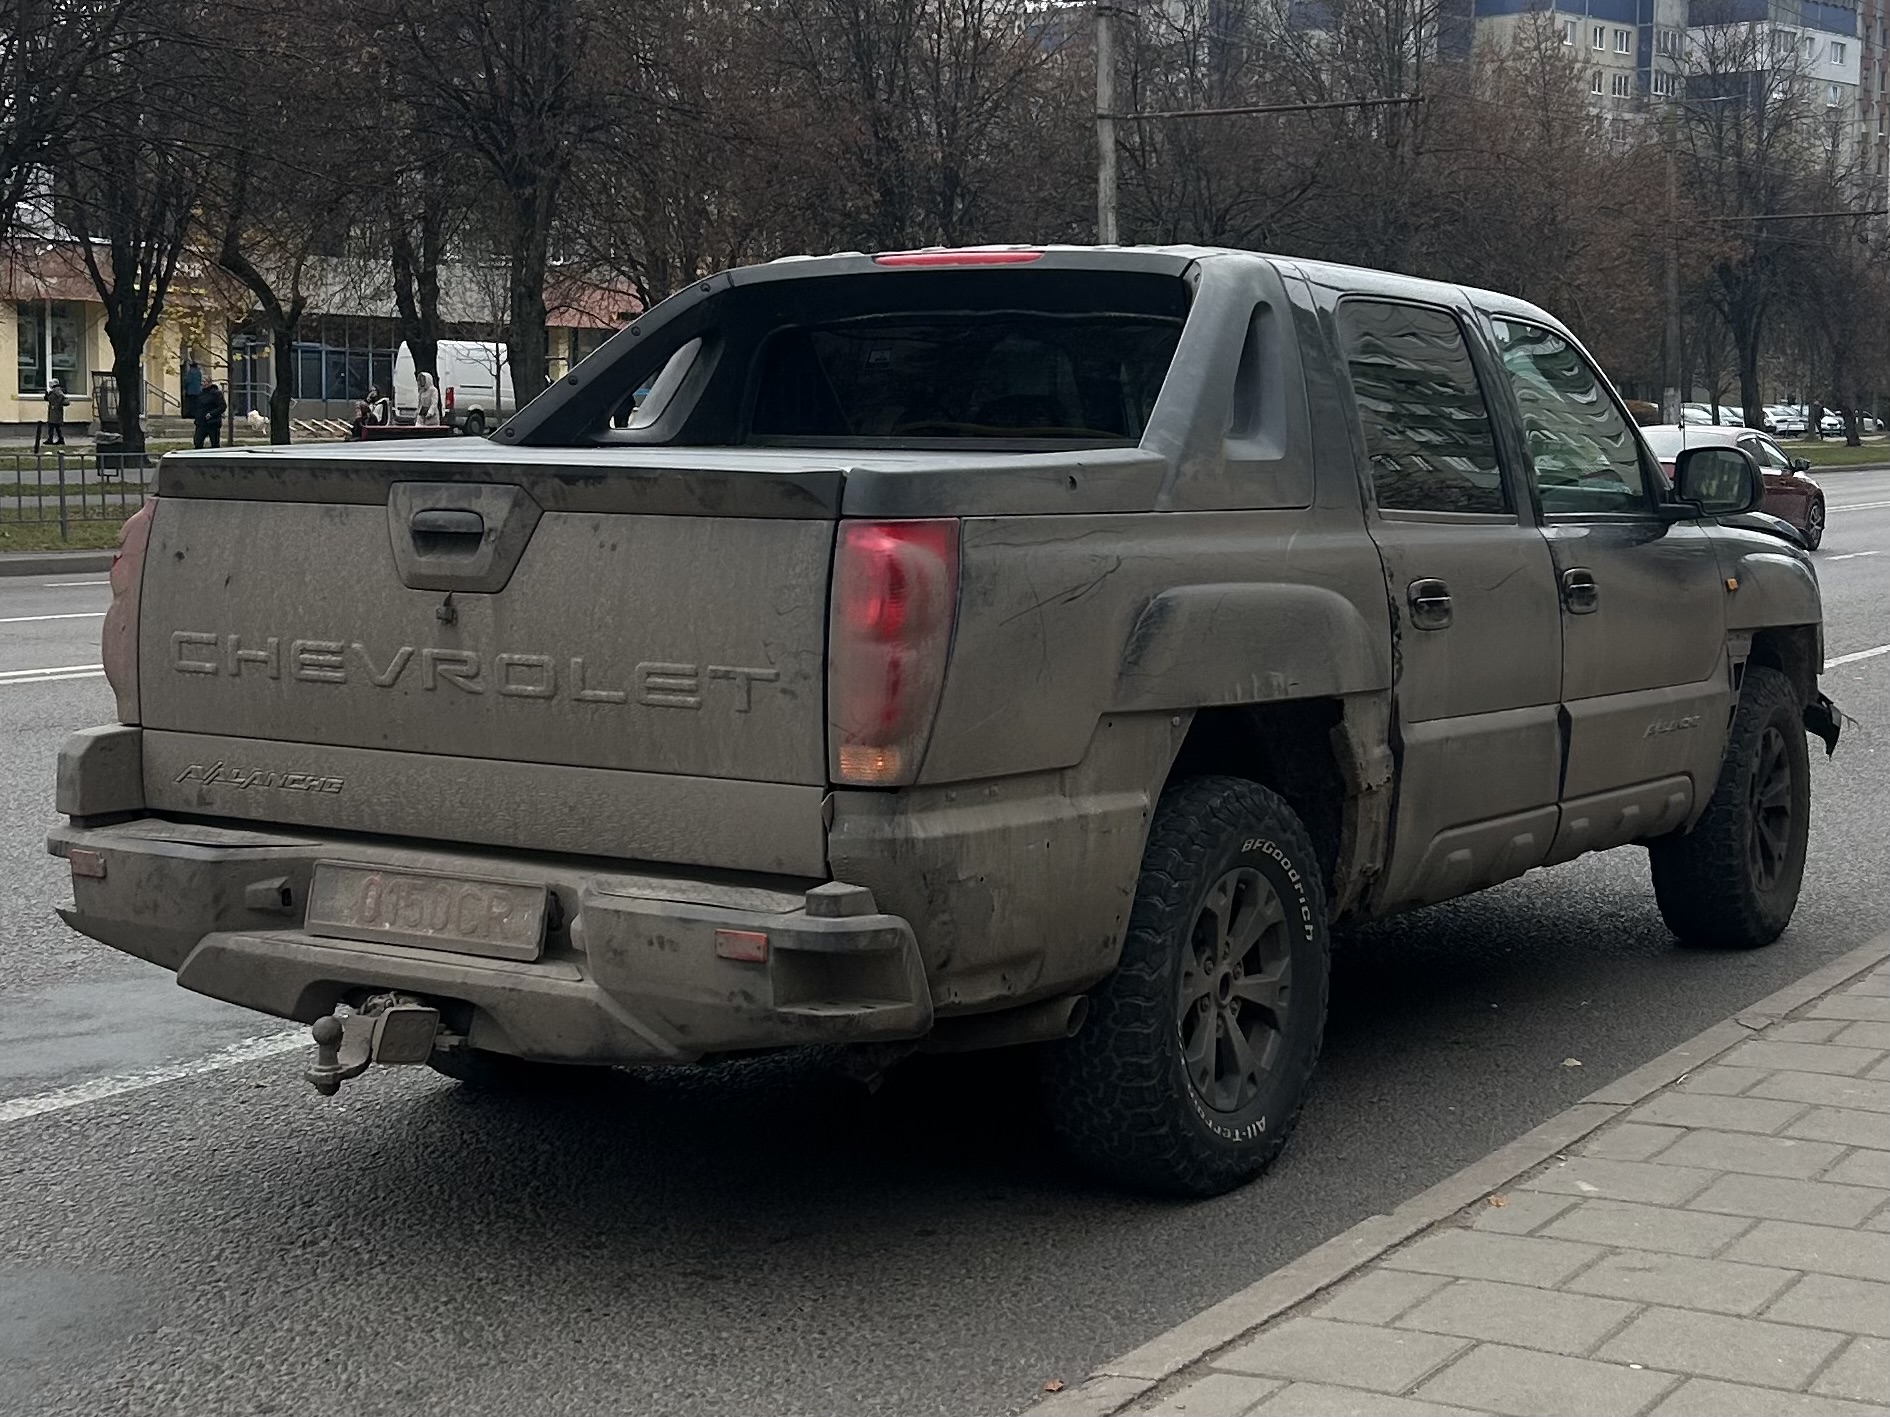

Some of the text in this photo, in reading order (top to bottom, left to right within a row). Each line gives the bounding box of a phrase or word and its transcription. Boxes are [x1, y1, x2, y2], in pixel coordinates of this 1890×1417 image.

[171, 630, 780, 713] CHEVROLET
[172, 760, 346, 794] AVALANCHE
[1242, 838, 1314, 942] BFGoodrich
